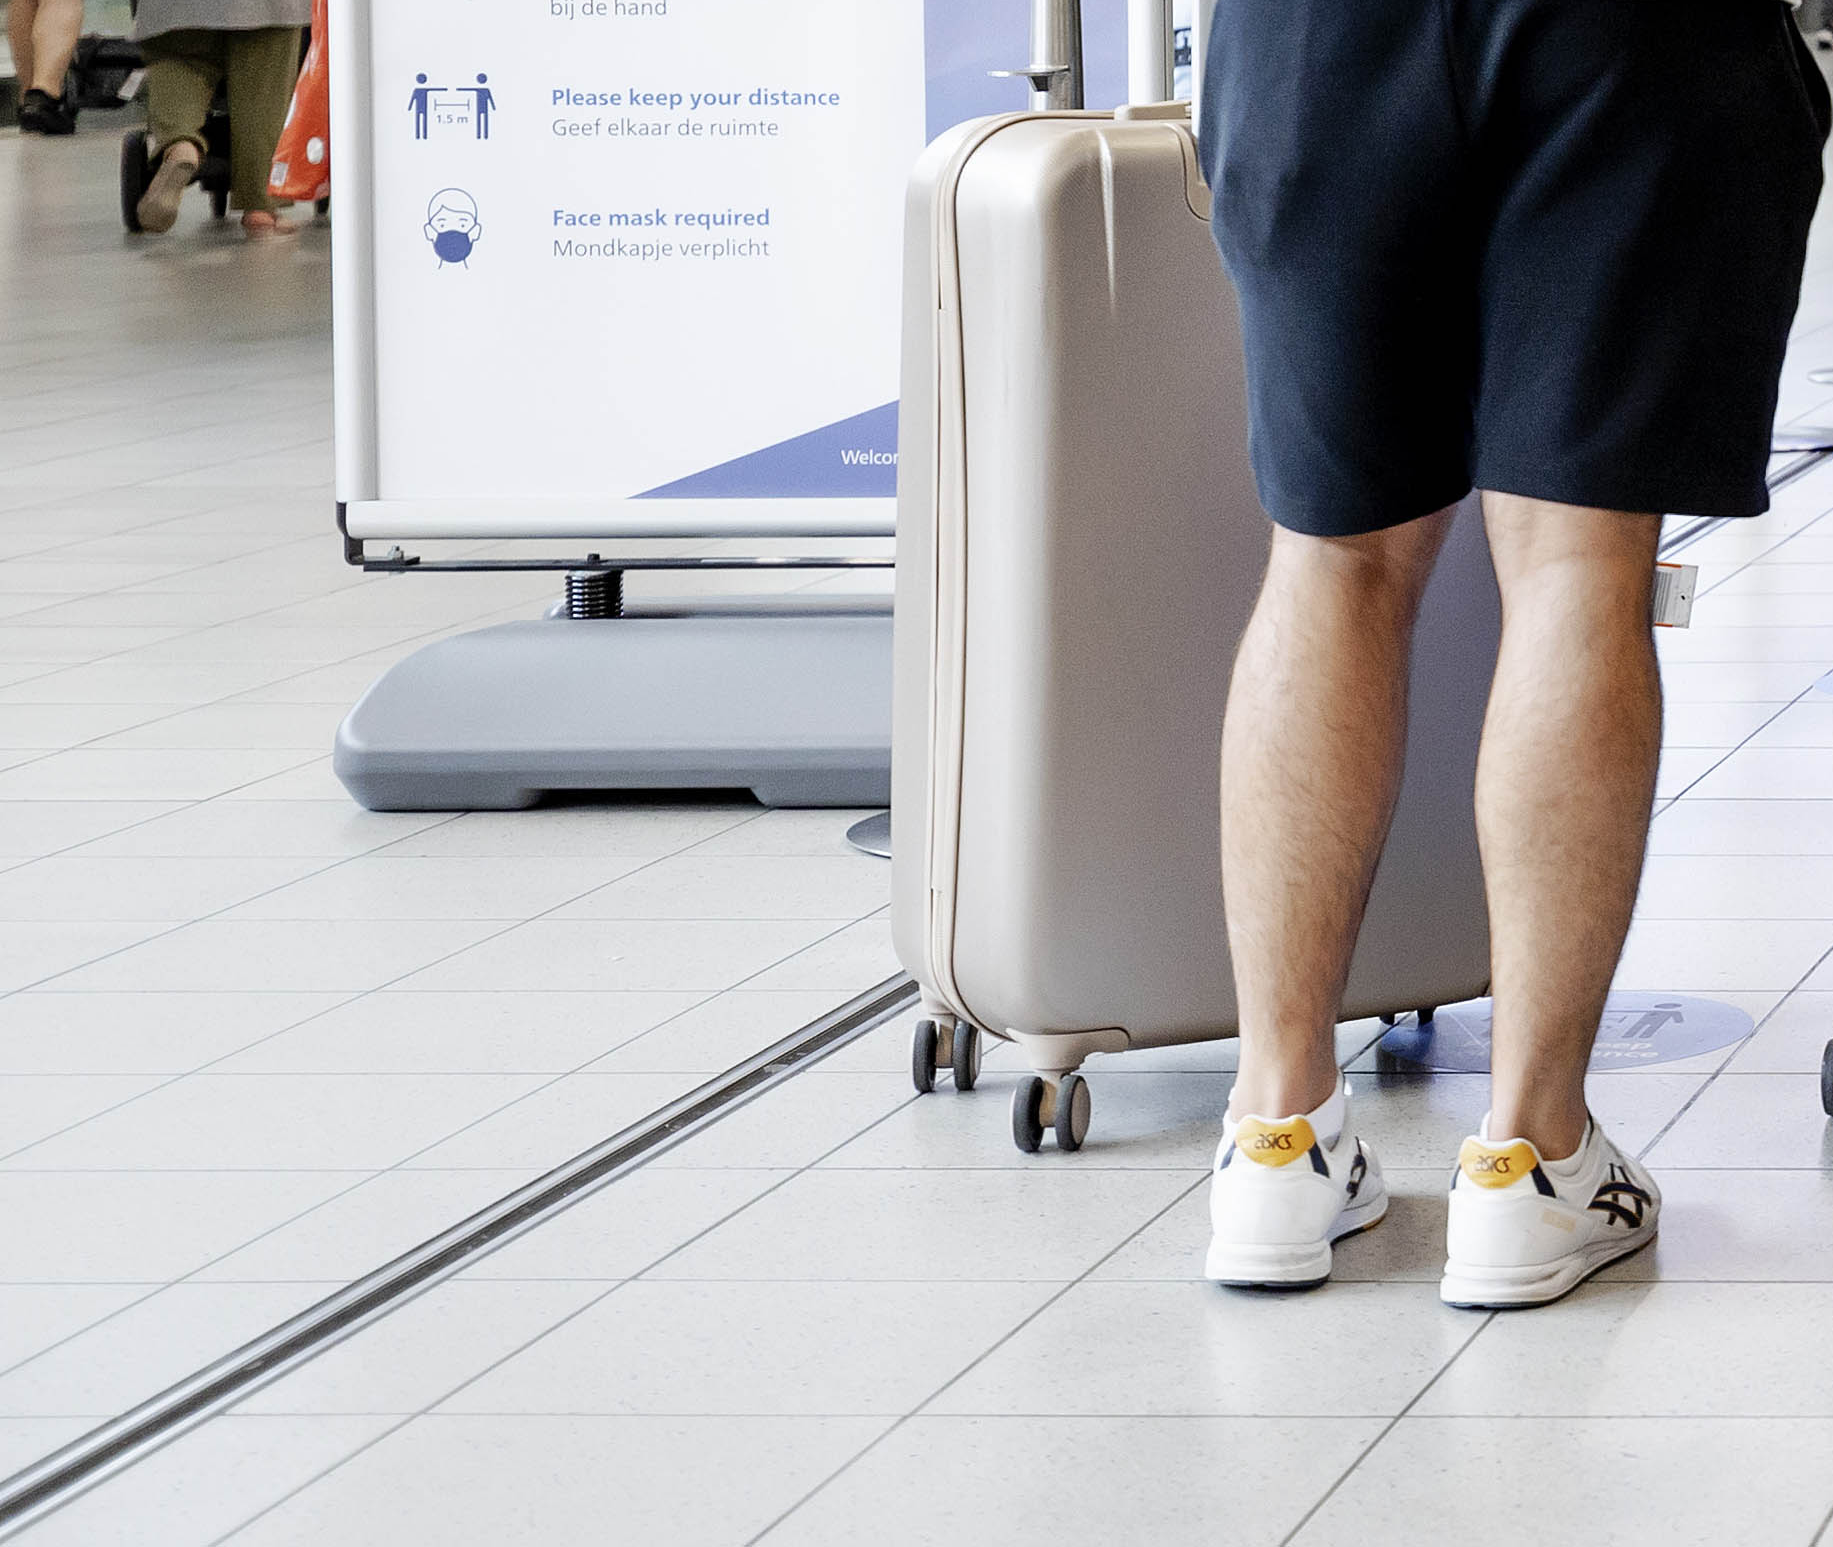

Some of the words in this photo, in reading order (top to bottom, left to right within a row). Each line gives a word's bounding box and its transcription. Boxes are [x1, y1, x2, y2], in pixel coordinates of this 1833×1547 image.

[553, 88, 622, 106] Please
[629, 88, 683, 110] keep
[690, 93, 741, 110] your
[748, 88, 840, 105] distance
[436, 114, 454, 124] 1.5
[457, 116, 468, 124] m
[552, 118, 601, 136] Geef
[608, 118, 671, 136] elkaar
[678, 118, 703, 136] de
[710, 118, 778, 136] ruimte
[554, 210, 601, 226] Face
[609, 208, 667, 226] mask
[675, 208, 769, 230] required
[554, 238, 673, 261] Mondkapje
[679, 238, 769, 260] verplicht
[840, 449, 899, 466] Welco
